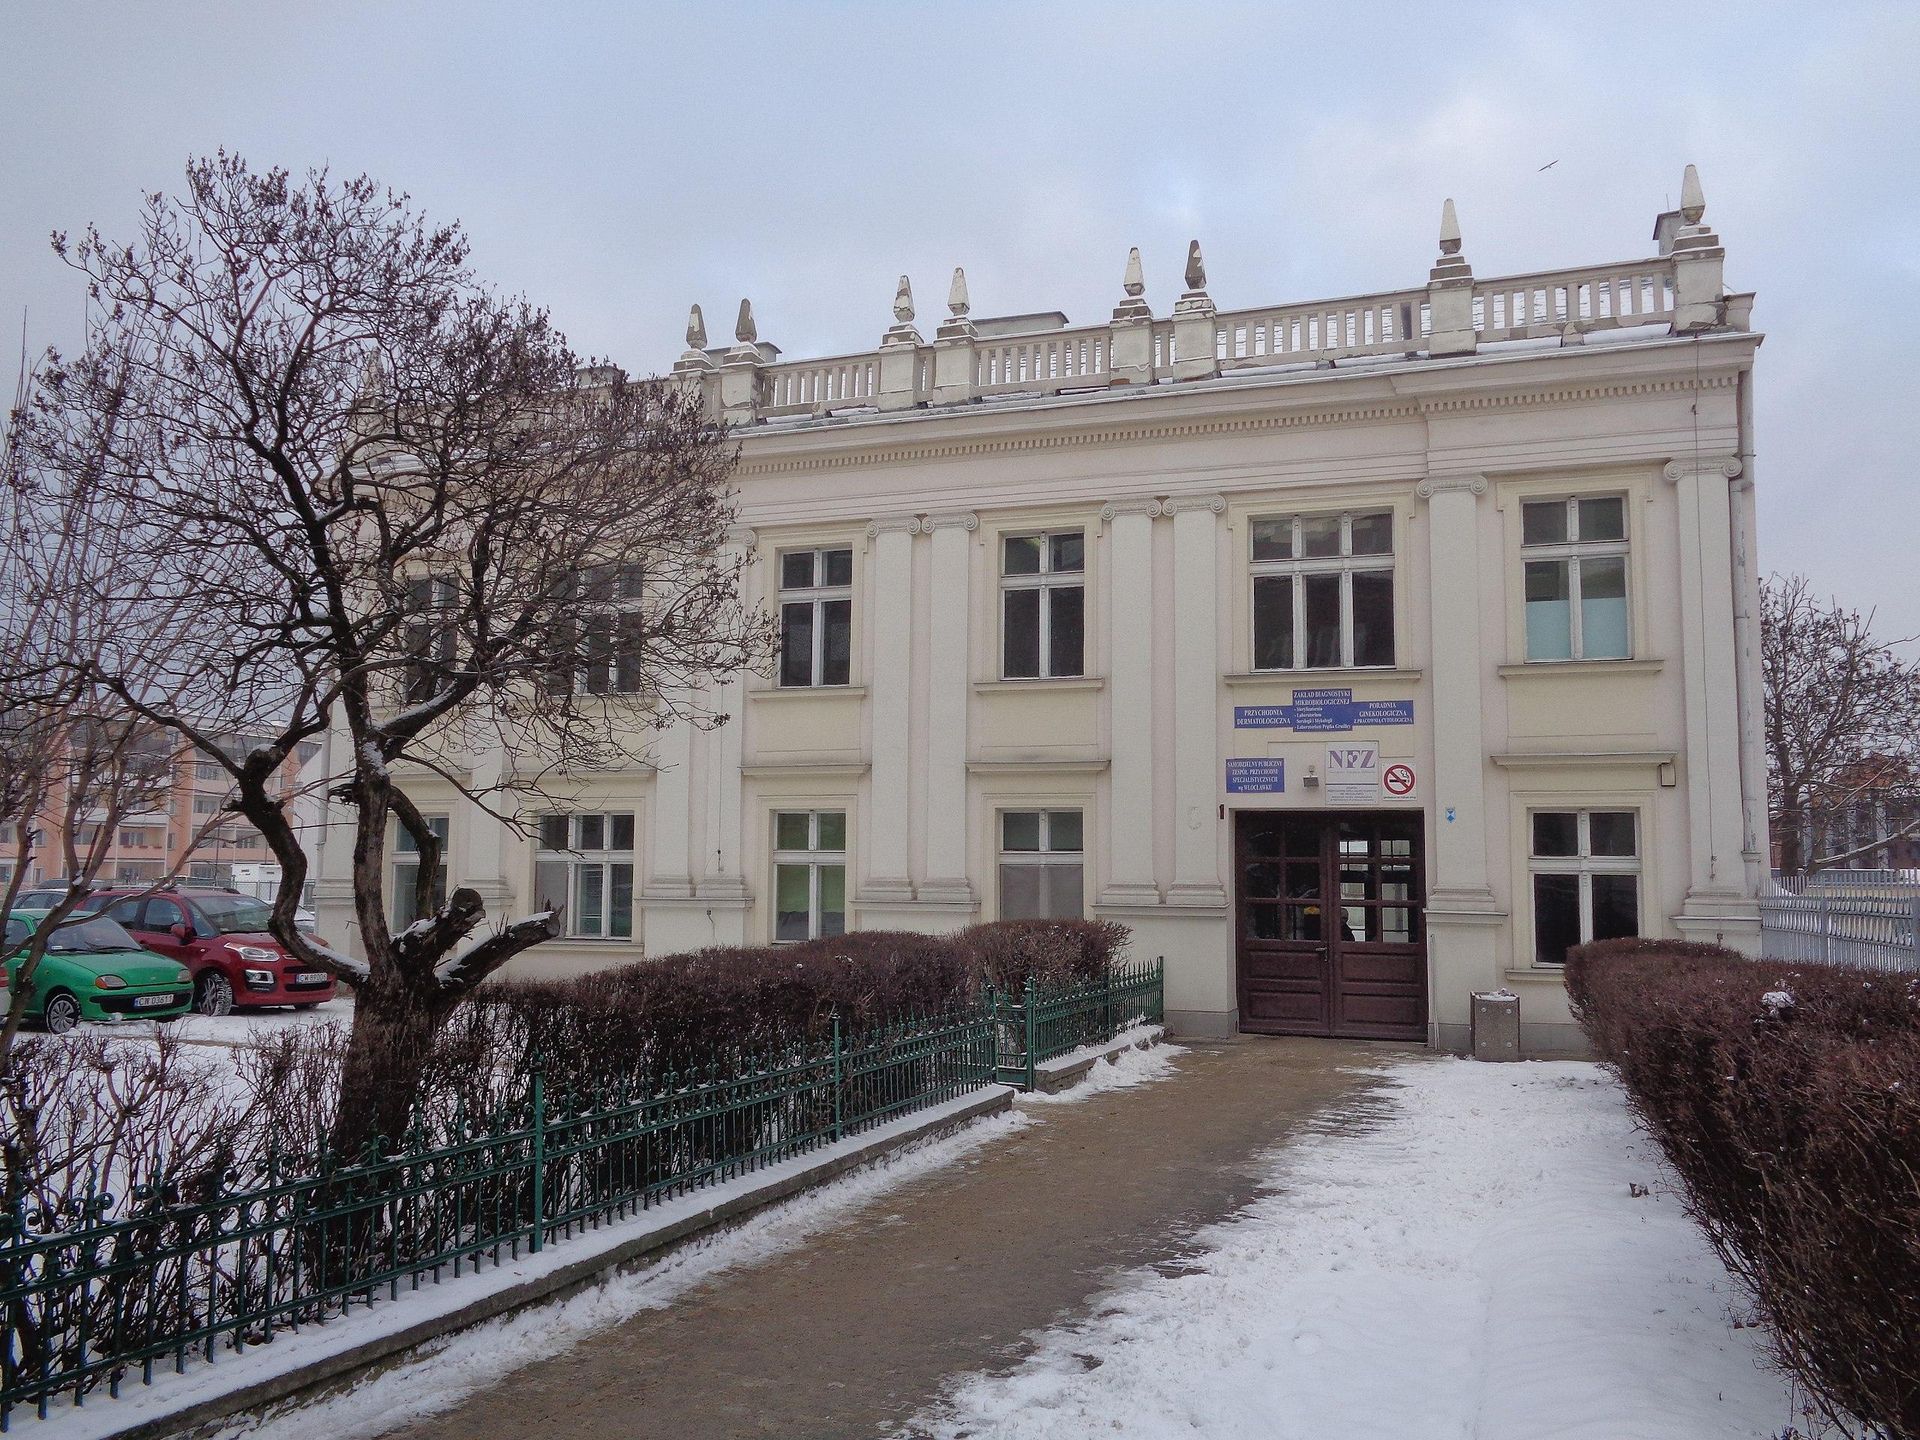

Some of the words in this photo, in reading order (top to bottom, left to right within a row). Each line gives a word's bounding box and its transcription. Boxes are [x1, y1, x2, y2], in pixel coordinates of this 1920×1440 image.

[1315, 690, 1350, 698] DIAGNOSTYKI
[1236, 717, 1291, 725] DERMATOLOGICZNA
[1328, 750, 1376, 769] NFZ
